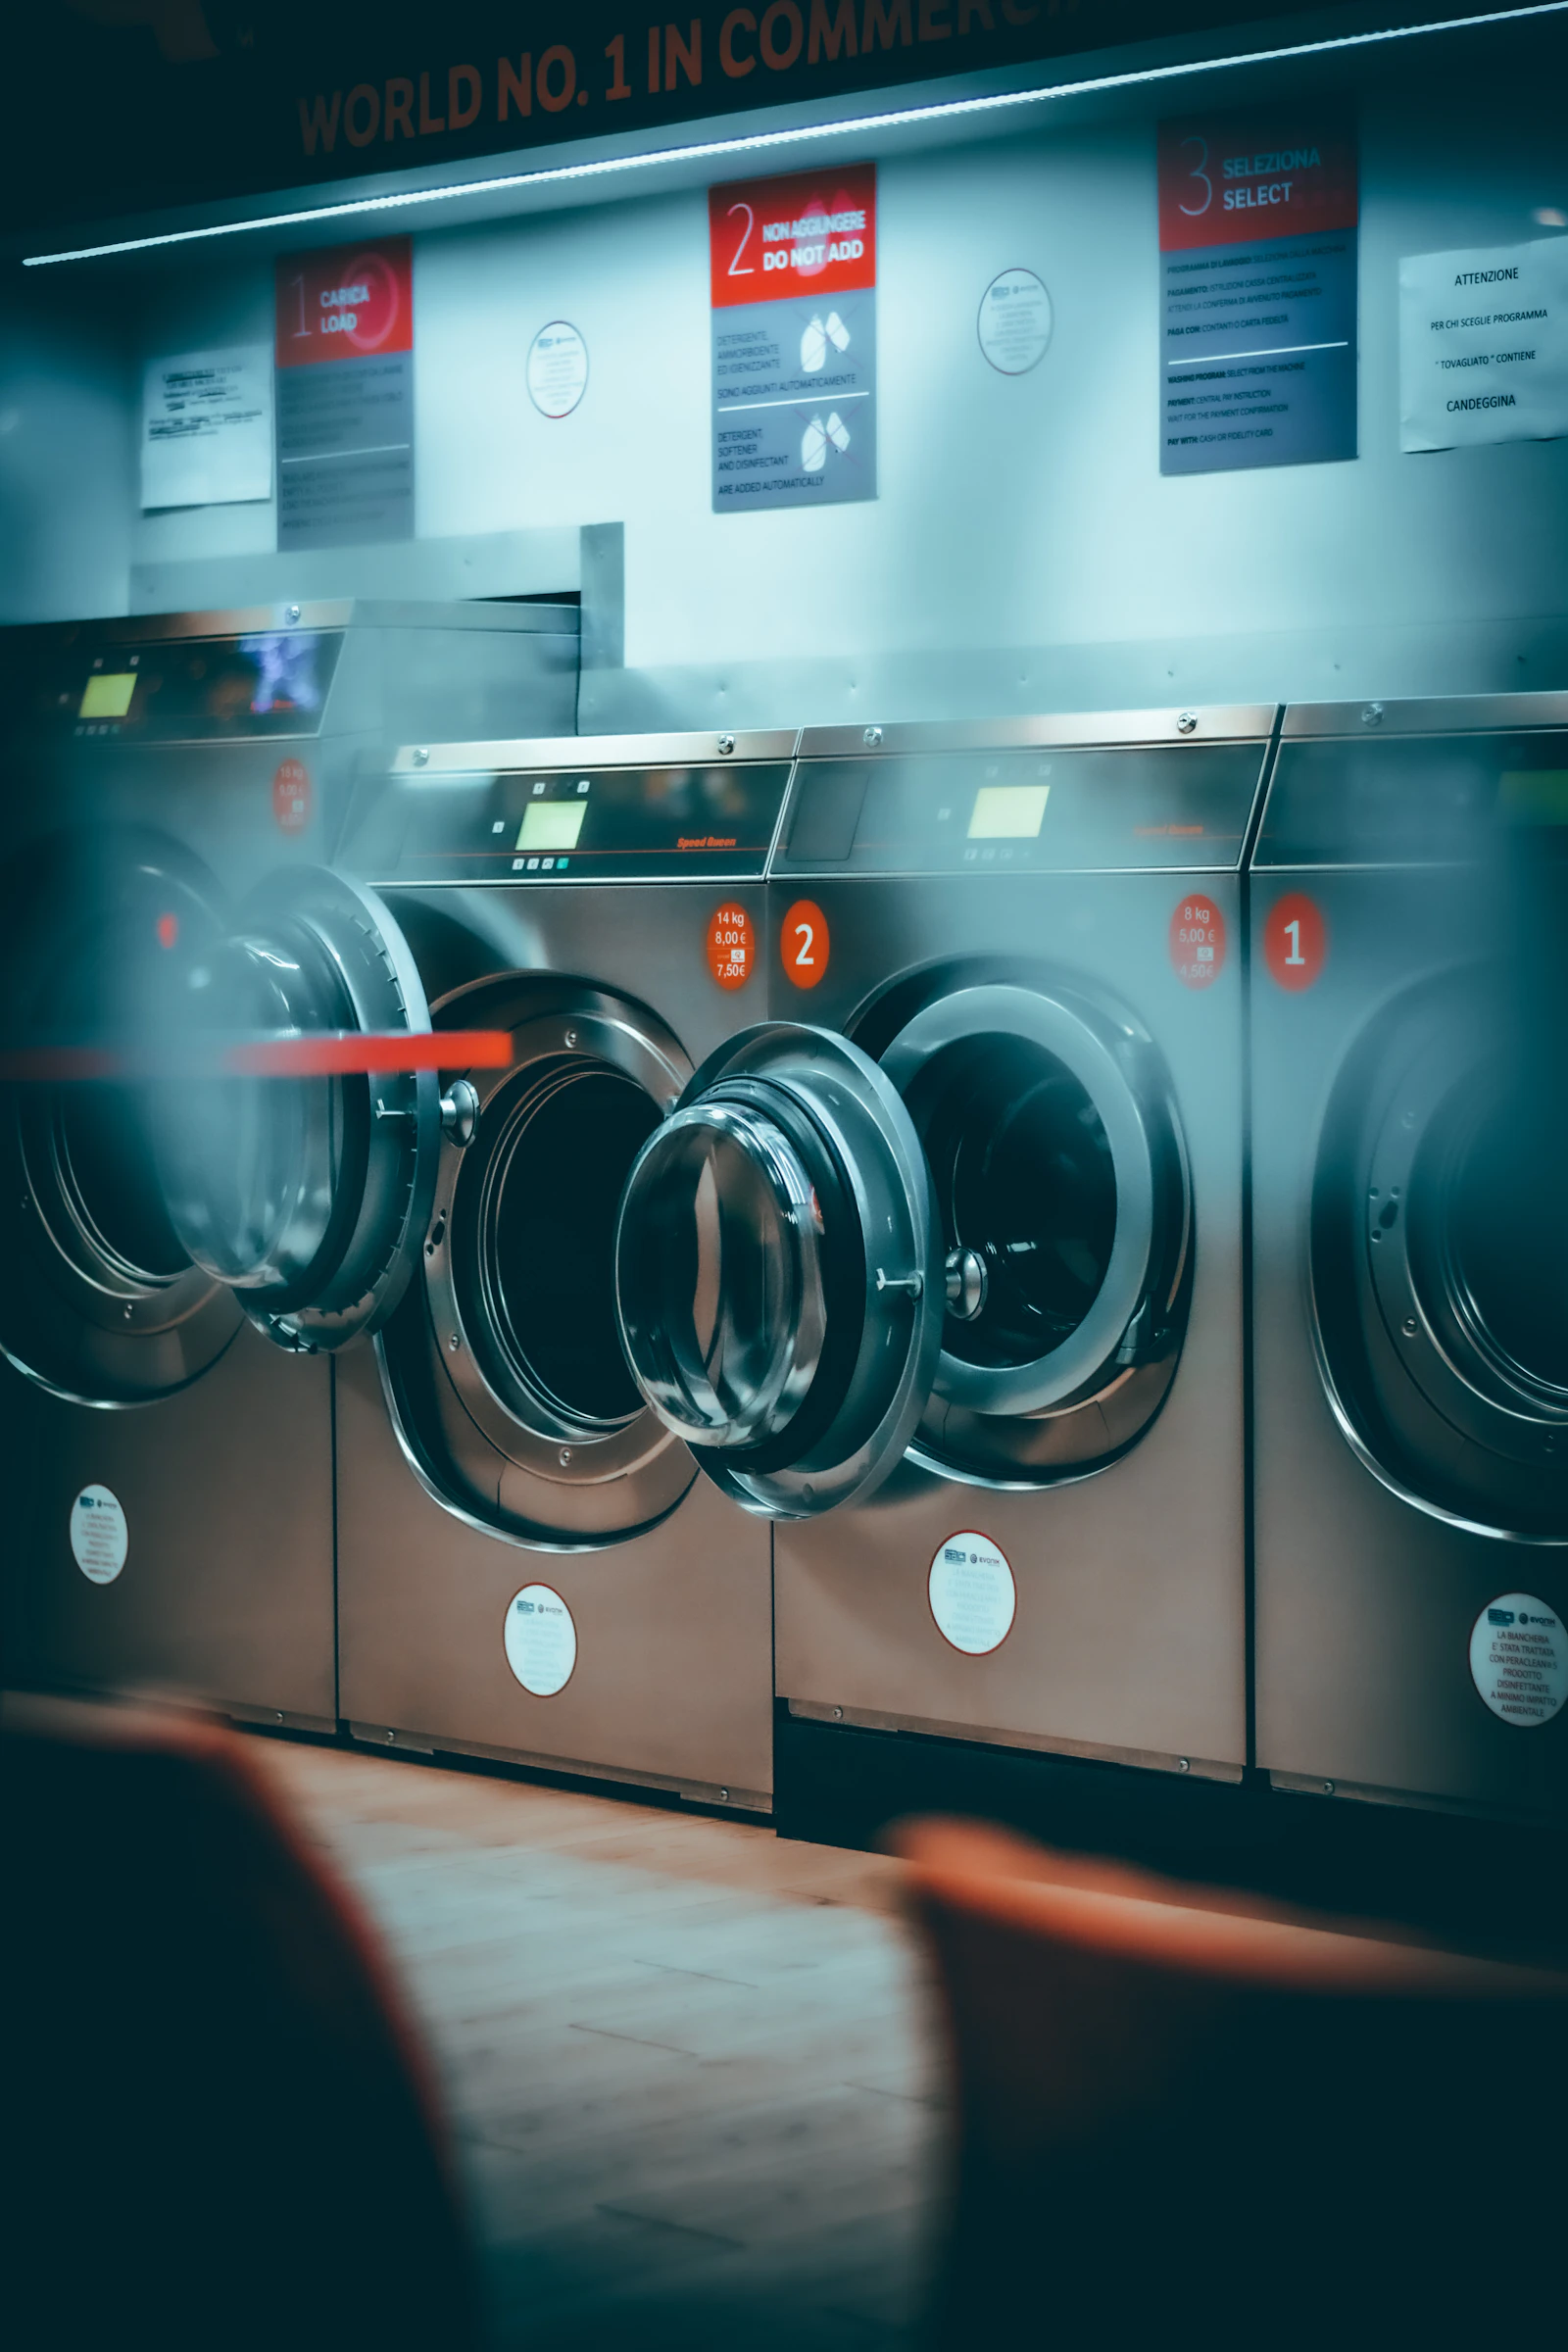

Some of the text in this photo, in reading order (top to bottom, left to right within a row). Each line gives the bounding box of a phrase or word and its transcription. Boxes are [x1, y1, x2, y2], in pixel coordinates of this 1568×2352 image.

[297, 0, 1080, 156] WORLD NO. 1 IN COMMER
[1222, 146, 1321, 179] SELEZIONA
[1178, 135, 1212, 217] 3
[1222, 181, 1293, 211] SELECT
[762, 210, 866, 243] NON AGGIUNGERE
[727, 203, 755, 275] 2
[763, 239, 864, 271] DO NOT ADD
[1454, 268, 1519, 286] ATTENZIONE
[320, 284, 370, 308] CARICA
[1167, 285, 1208, 297] PAGAMENTO:
[1245, 278, 1265, 287] CASSA
[1194, 302, 1201, 311] LA
[1202, 297, 1239, 309] CONFERMA
[1239, 296, 1246, 305] DI
[1281, 287, 1322, 299] PAGAMENTO
[321, 313, 358, 334] LOAD
[1167, 327, 1184, 336] PAGA
[1201, 321, 1234, 332] CONTANTI
[1241, 318, 1260, 327] CARTA
[1431, 309, 1547, 331] PER CHI SCEGLIE PROGRAMMA
[1441, 356, 1489, 369] TOVAGLIATO
[1495, 350, 1536, 364] CONTIENE
[717, 366, 728, 375] ED
[1167, 373, 1195, 384] WASHING
[1226, 368, 1248, 378] SELECT
[1249, 367, 1265, 376] FROM
[1266, 364, 1278, 373] THE
[1278, 361, 1305, 372] MACHINE
[717, 373, 858, 399] SONO AGGIUNTI AUTOMATICAMENTE
[1196, 395, 1221, 404] CENTRAL
[1234, 389, 1271, 400] INSTRUCTION
[1446, 394, 1516, 412] CANDEGGINA
[1198, 412, 1209, 420] THE
[1210, 409, 1239, 418] PAYMENT
[1240, 404, 1289, 416] CONFIRMATION
[1180, 435, 1199, 445] WITH:
[1199, 434, 1216, 443] CASH
[1227, 430, 1254, 440] FIDELITY
[1254, 428, 1273, 438] CARD
[718, 444, 758, 457] SOFTENER
[718, 455, 789, 471] AND DISINFECTANT
[718, 475, 825, 496] ARE ADDED AUTOMATICALLY
[677, 836, 737, 850] Speed Queen
[717, 911, 745, 927] 14 kg
[1184, 906, 1210, 923] 8 kg
[715, 931, 738, 947] 8,00
[794, 922, 814, 965] 2
[1179, 928, 1204, 944] 5,00
[1284, 919, 1305, 965] 1
[1496, 1631, 1549, 1643] LA BIANCHERIA
[1490, 1654, 1505, 1664] CON
[1499, 1643, 1520, 1653] STATA
[1521, 1645, 1555, 1657] TRATTATA
[1502, 1668, 1543, 1680] PRODOTTO
[1496, 1679, 1550, 1693] DISINFETTANTE
[1496, 1692, 1526, 1703] MINIMO
[1526, 1696, 1557, 1706] IMPATTO
[1500, 1704, 1544, 1718] AMBIENTALE
